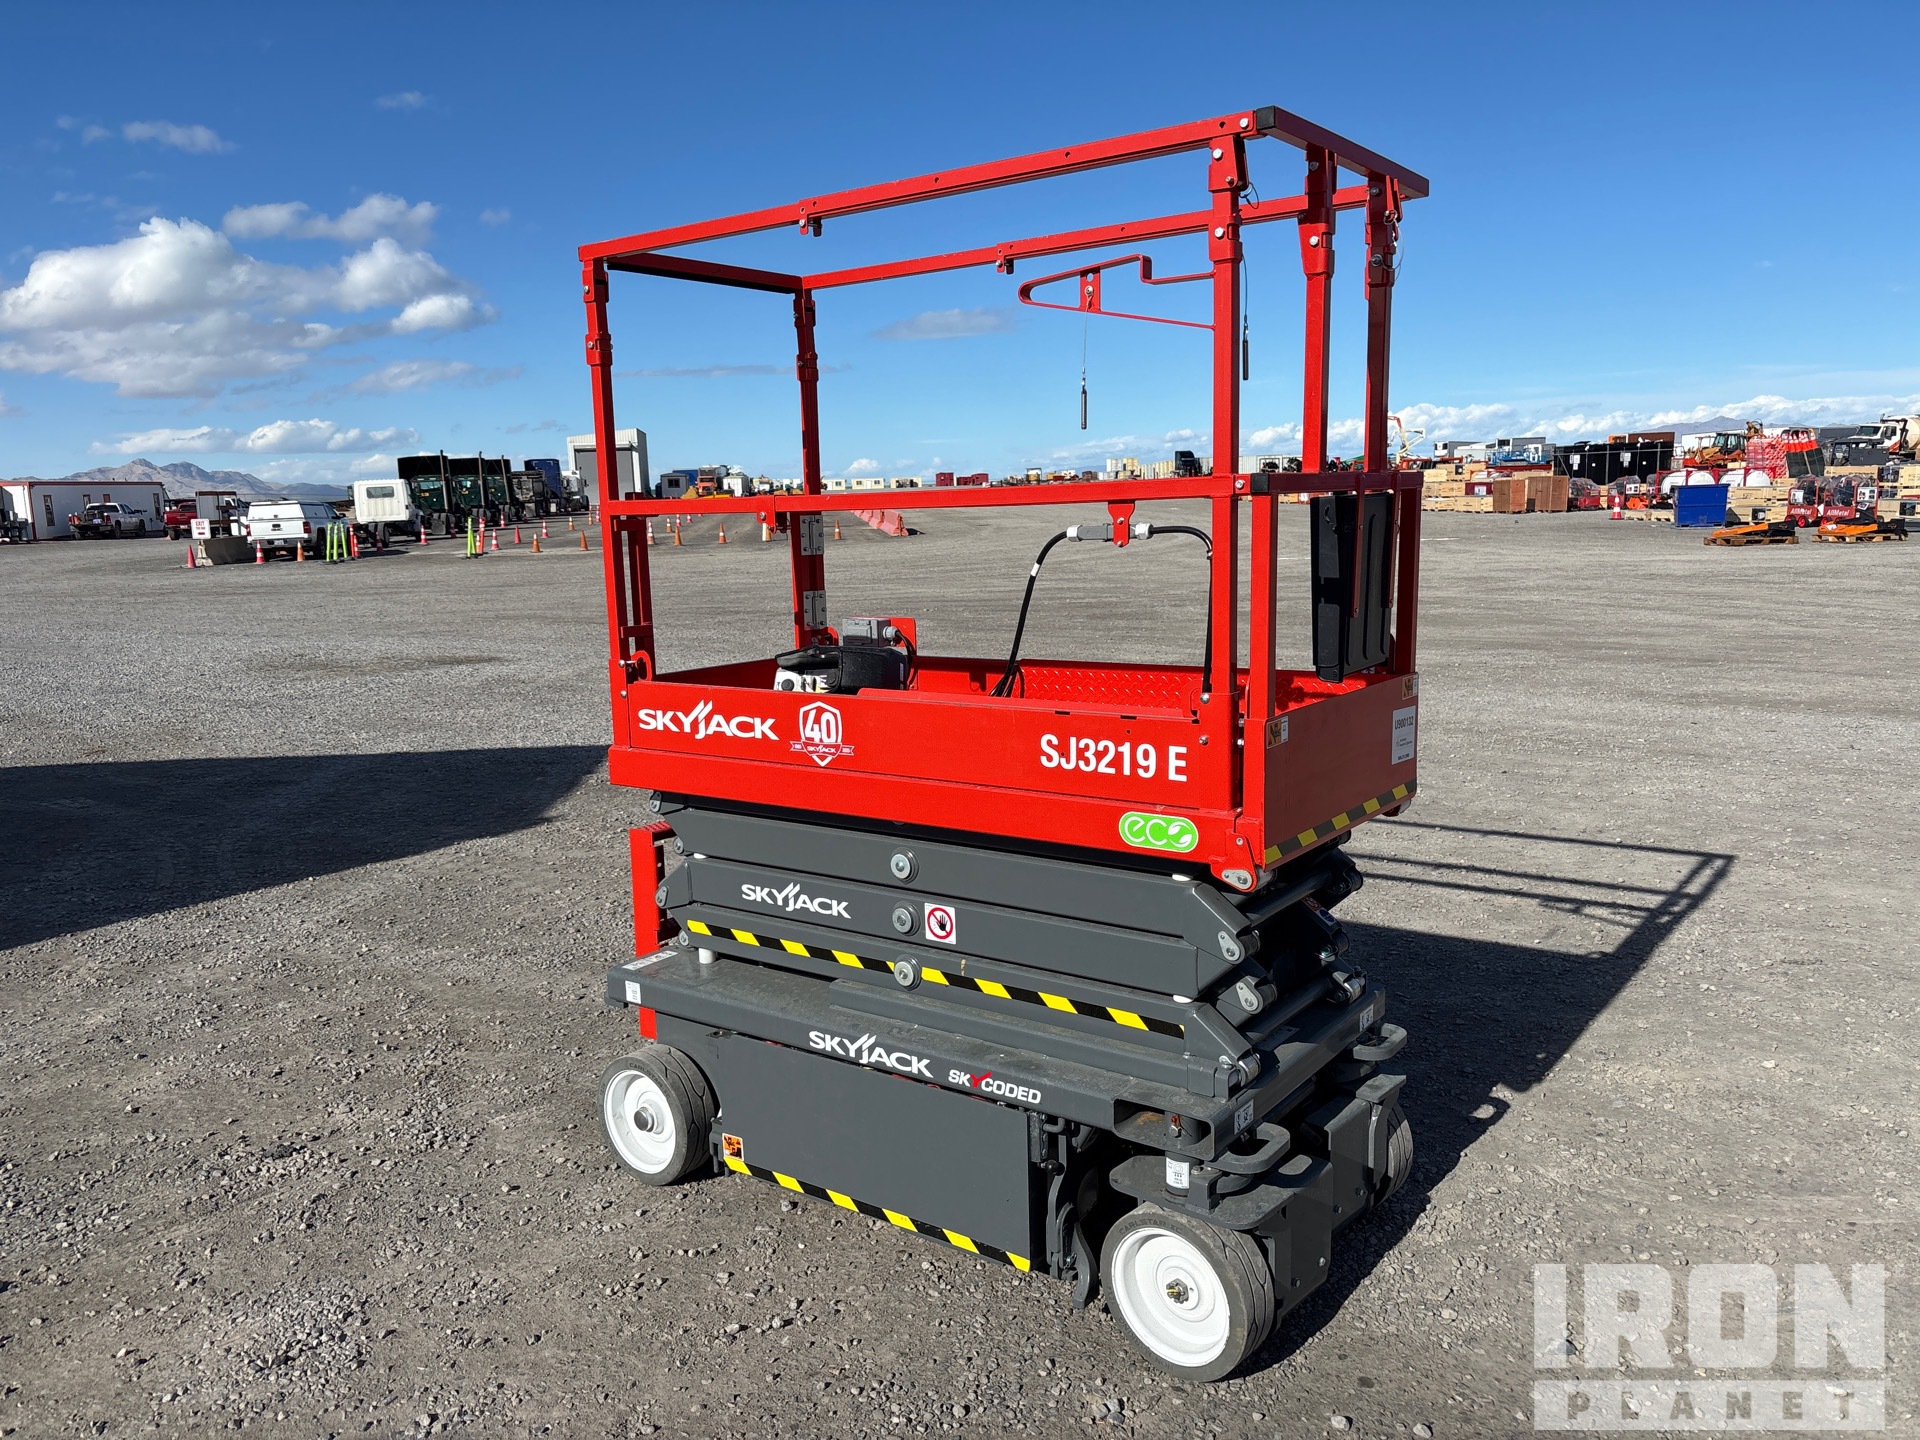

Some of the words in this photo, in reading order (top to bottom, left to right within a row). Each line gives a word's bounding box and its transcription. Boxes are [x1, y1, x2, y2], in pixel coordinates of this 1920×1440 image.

[638, 699, 780, 740] SKYJACK
[805, 709, 836, 743] 40
[1040, 734, 1157, 778] SJ3219
[1168, 745, 1187, 782] E
[741, 882, 851, 919] SKYJACK
[809, 1031, 934, 1078] SKYJACK
[948, 1069, 1041, 1104] SKYCODED
[1119, 1219, 1167, 1235] CARLSTAR
